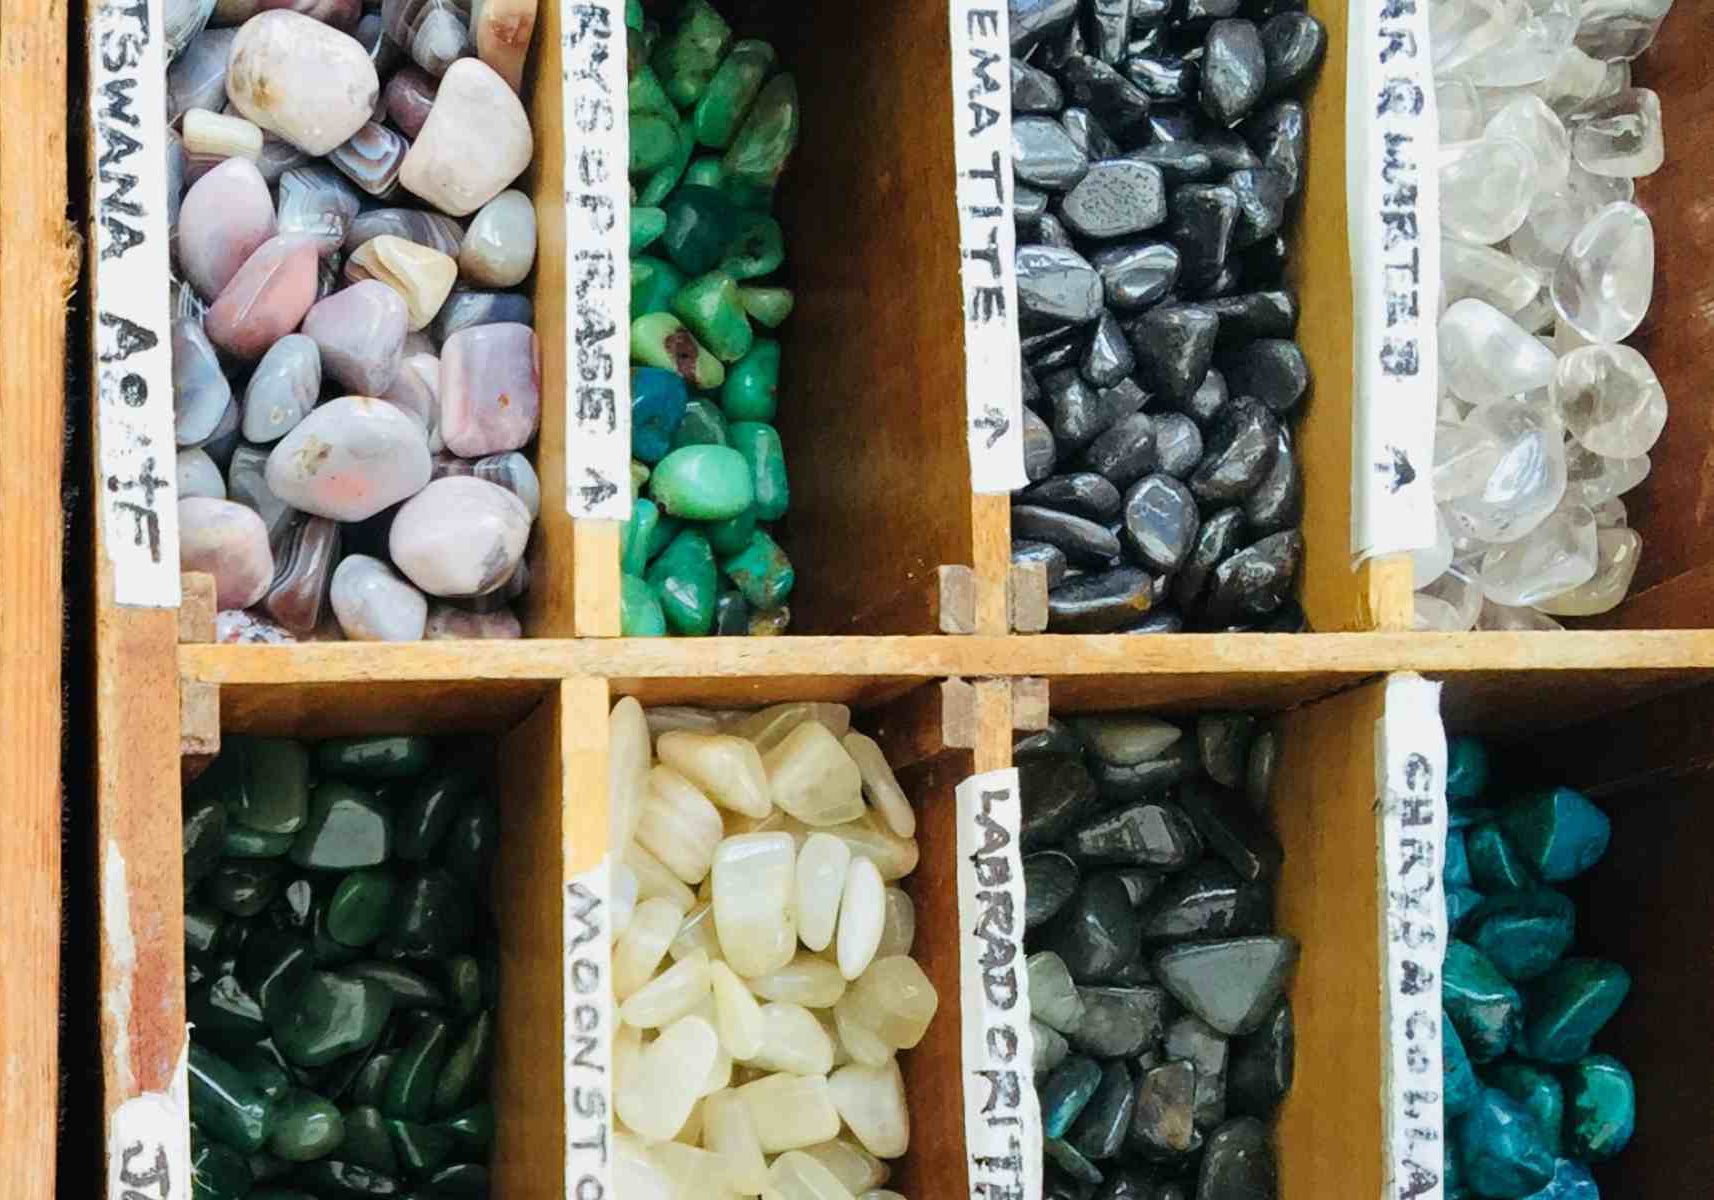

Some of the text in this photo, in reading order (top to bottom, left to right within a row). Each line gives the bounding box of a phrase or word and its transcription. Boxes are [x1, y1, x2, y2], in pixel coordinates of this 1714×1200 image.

[97, 0, 151, 263] TSWANA
[962, 8, 1007, 328] EMATITE
[120, 1139, 171, 1200] J
